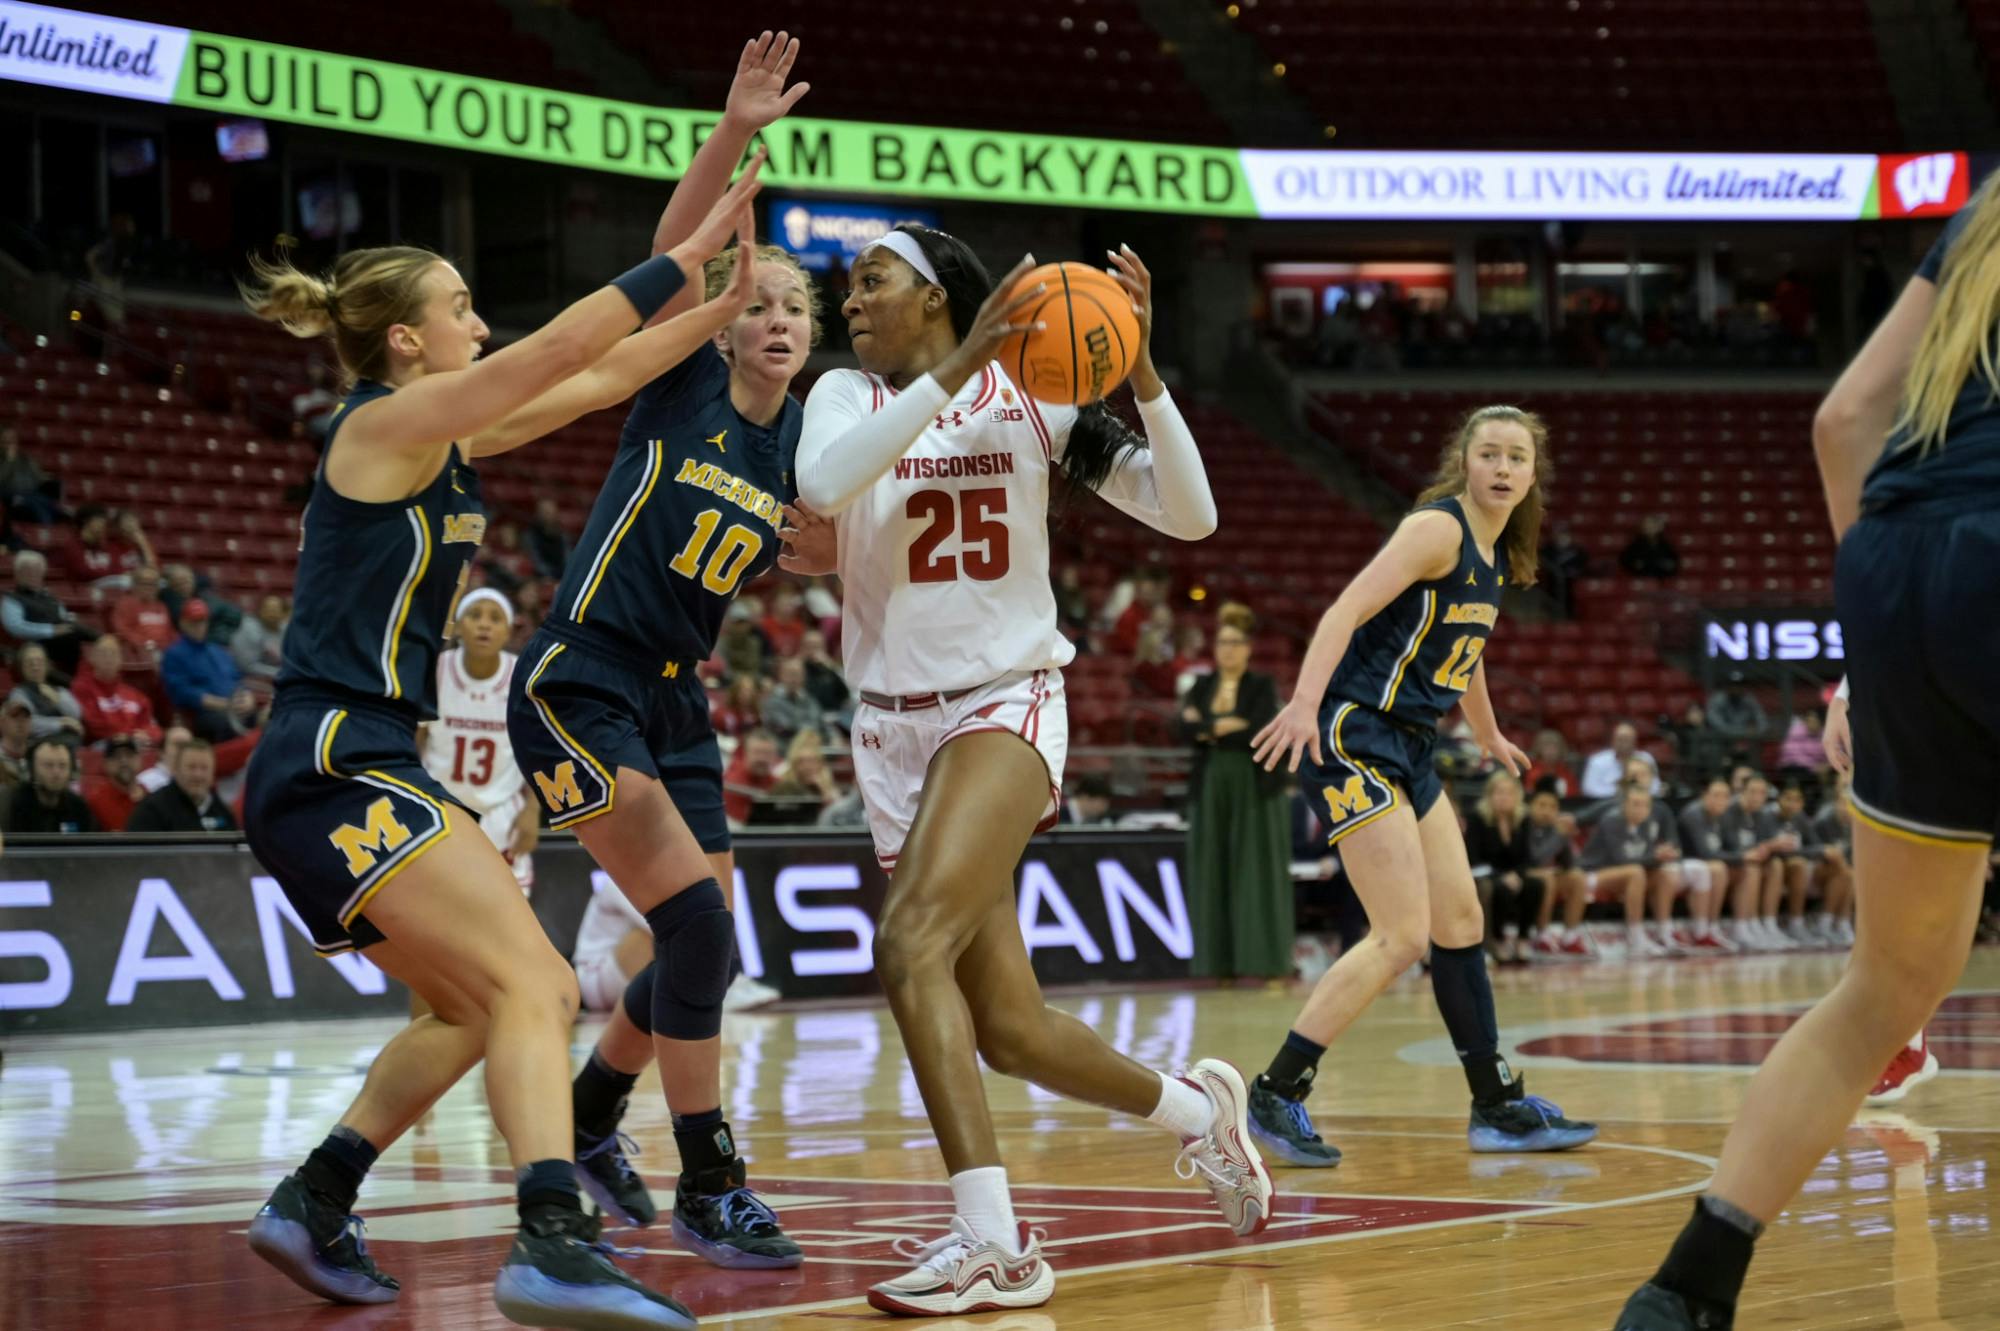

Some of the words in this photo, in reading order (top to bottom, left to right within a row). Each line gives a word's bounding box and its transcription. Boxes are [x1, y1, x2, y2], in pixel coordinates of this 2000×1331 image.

[193, 43, 384, 122] BUILD
[412, 76, 573, 154] YOUR
[871, 133, 1235, 203] BACKYARD
[1274, 166, 1485, 200] OUTDOOR
[1506, 167, 1650, 201] LIVING
[1665, 161, 1845, 199] Unlimited
[674, 458, 787, 532] MICHIGA
[894, 452, 1015, 480] WISCONSIN
[668, 508, 763, 596] 10
[905, 487, 1010, 584] 25
[1432, 633, 1487, 692] 12
[450, 735, 496, 787] 13
[532, 759, 585, 813] M
[1322, 773, 1374, 825] M
[327, 795, 414, 879] M
